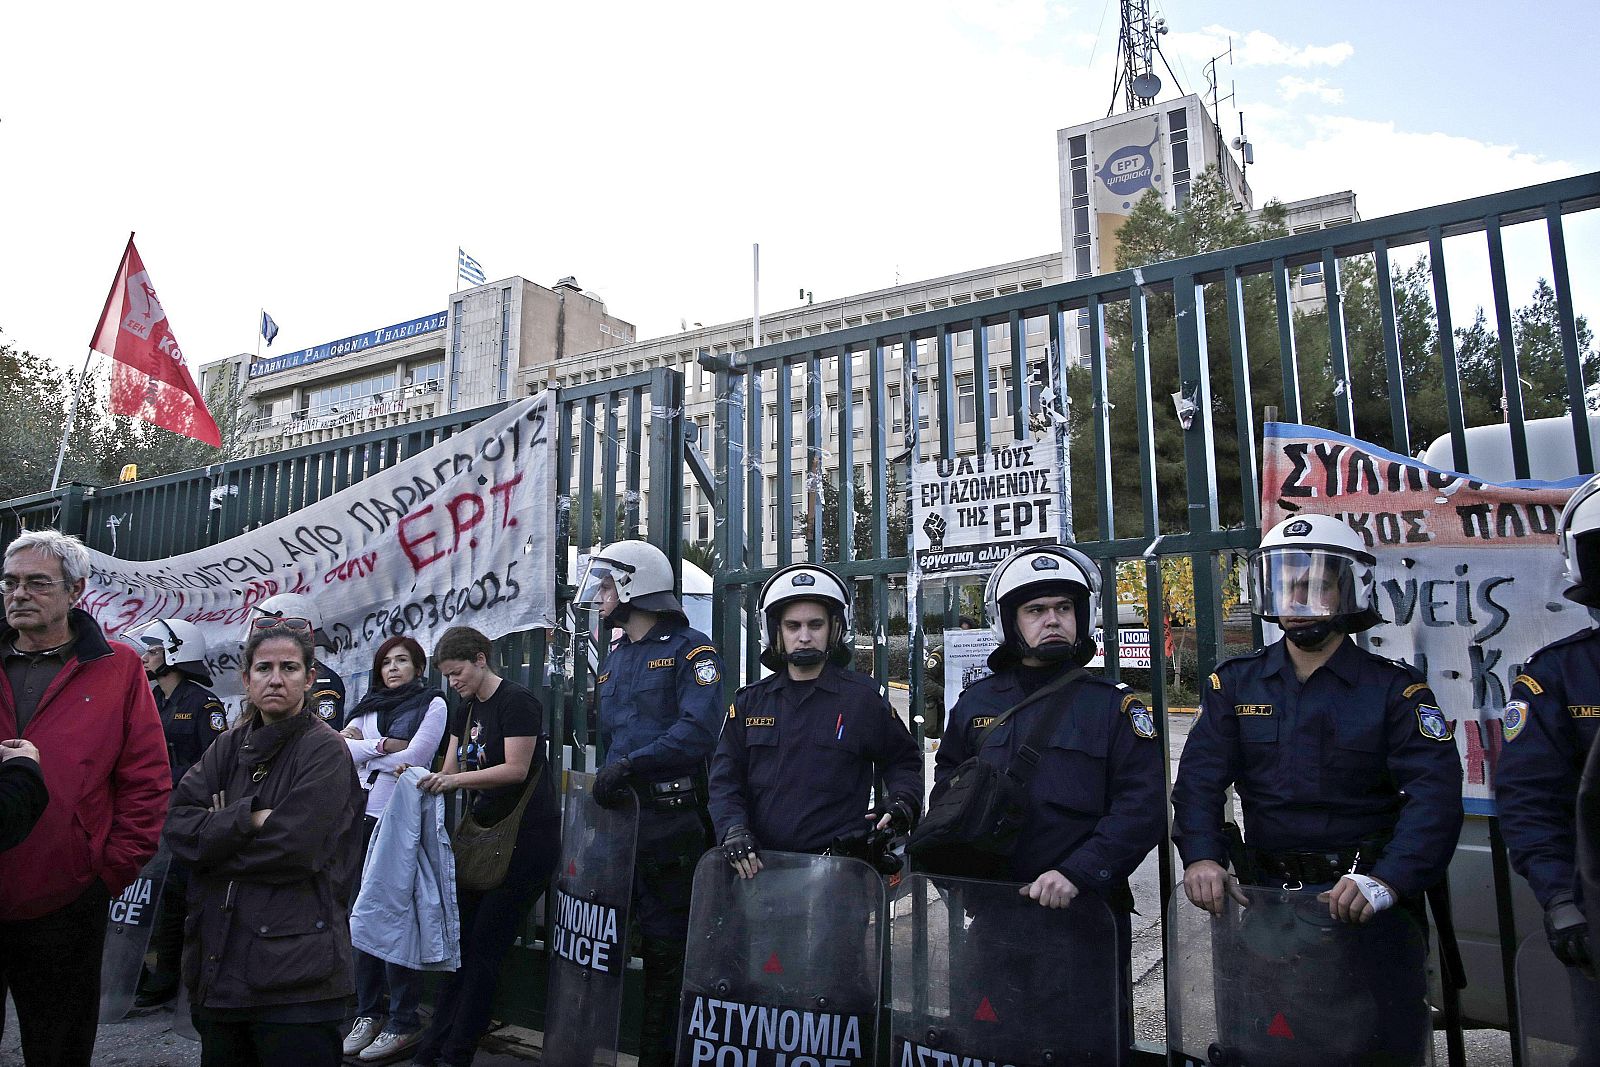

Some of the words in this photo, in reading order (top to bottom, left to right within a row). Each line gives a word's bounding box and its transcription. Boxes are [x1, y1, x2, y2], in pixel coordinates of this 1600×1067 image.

[1117, 158, 1139, 171] ΕΡΤ
[126, 319, 147, 335] ΣΕΚ
[374, 315, 447, 344] ΤΗΛΕΟΡΑΣΗ
[992, 446, 1034, 471] ΤΟΥΣ
[921, 468, 1051, 508] ΕΡΓΑΖΟΜΕΝΟΥΣ
[957, 505, 989, 528] ΤΗΣ
[993, 498, 1052, 538] ΕΡΤ
[687, 996, 862, 1059] ΑΣΤΥΝΟΜΙΑ
